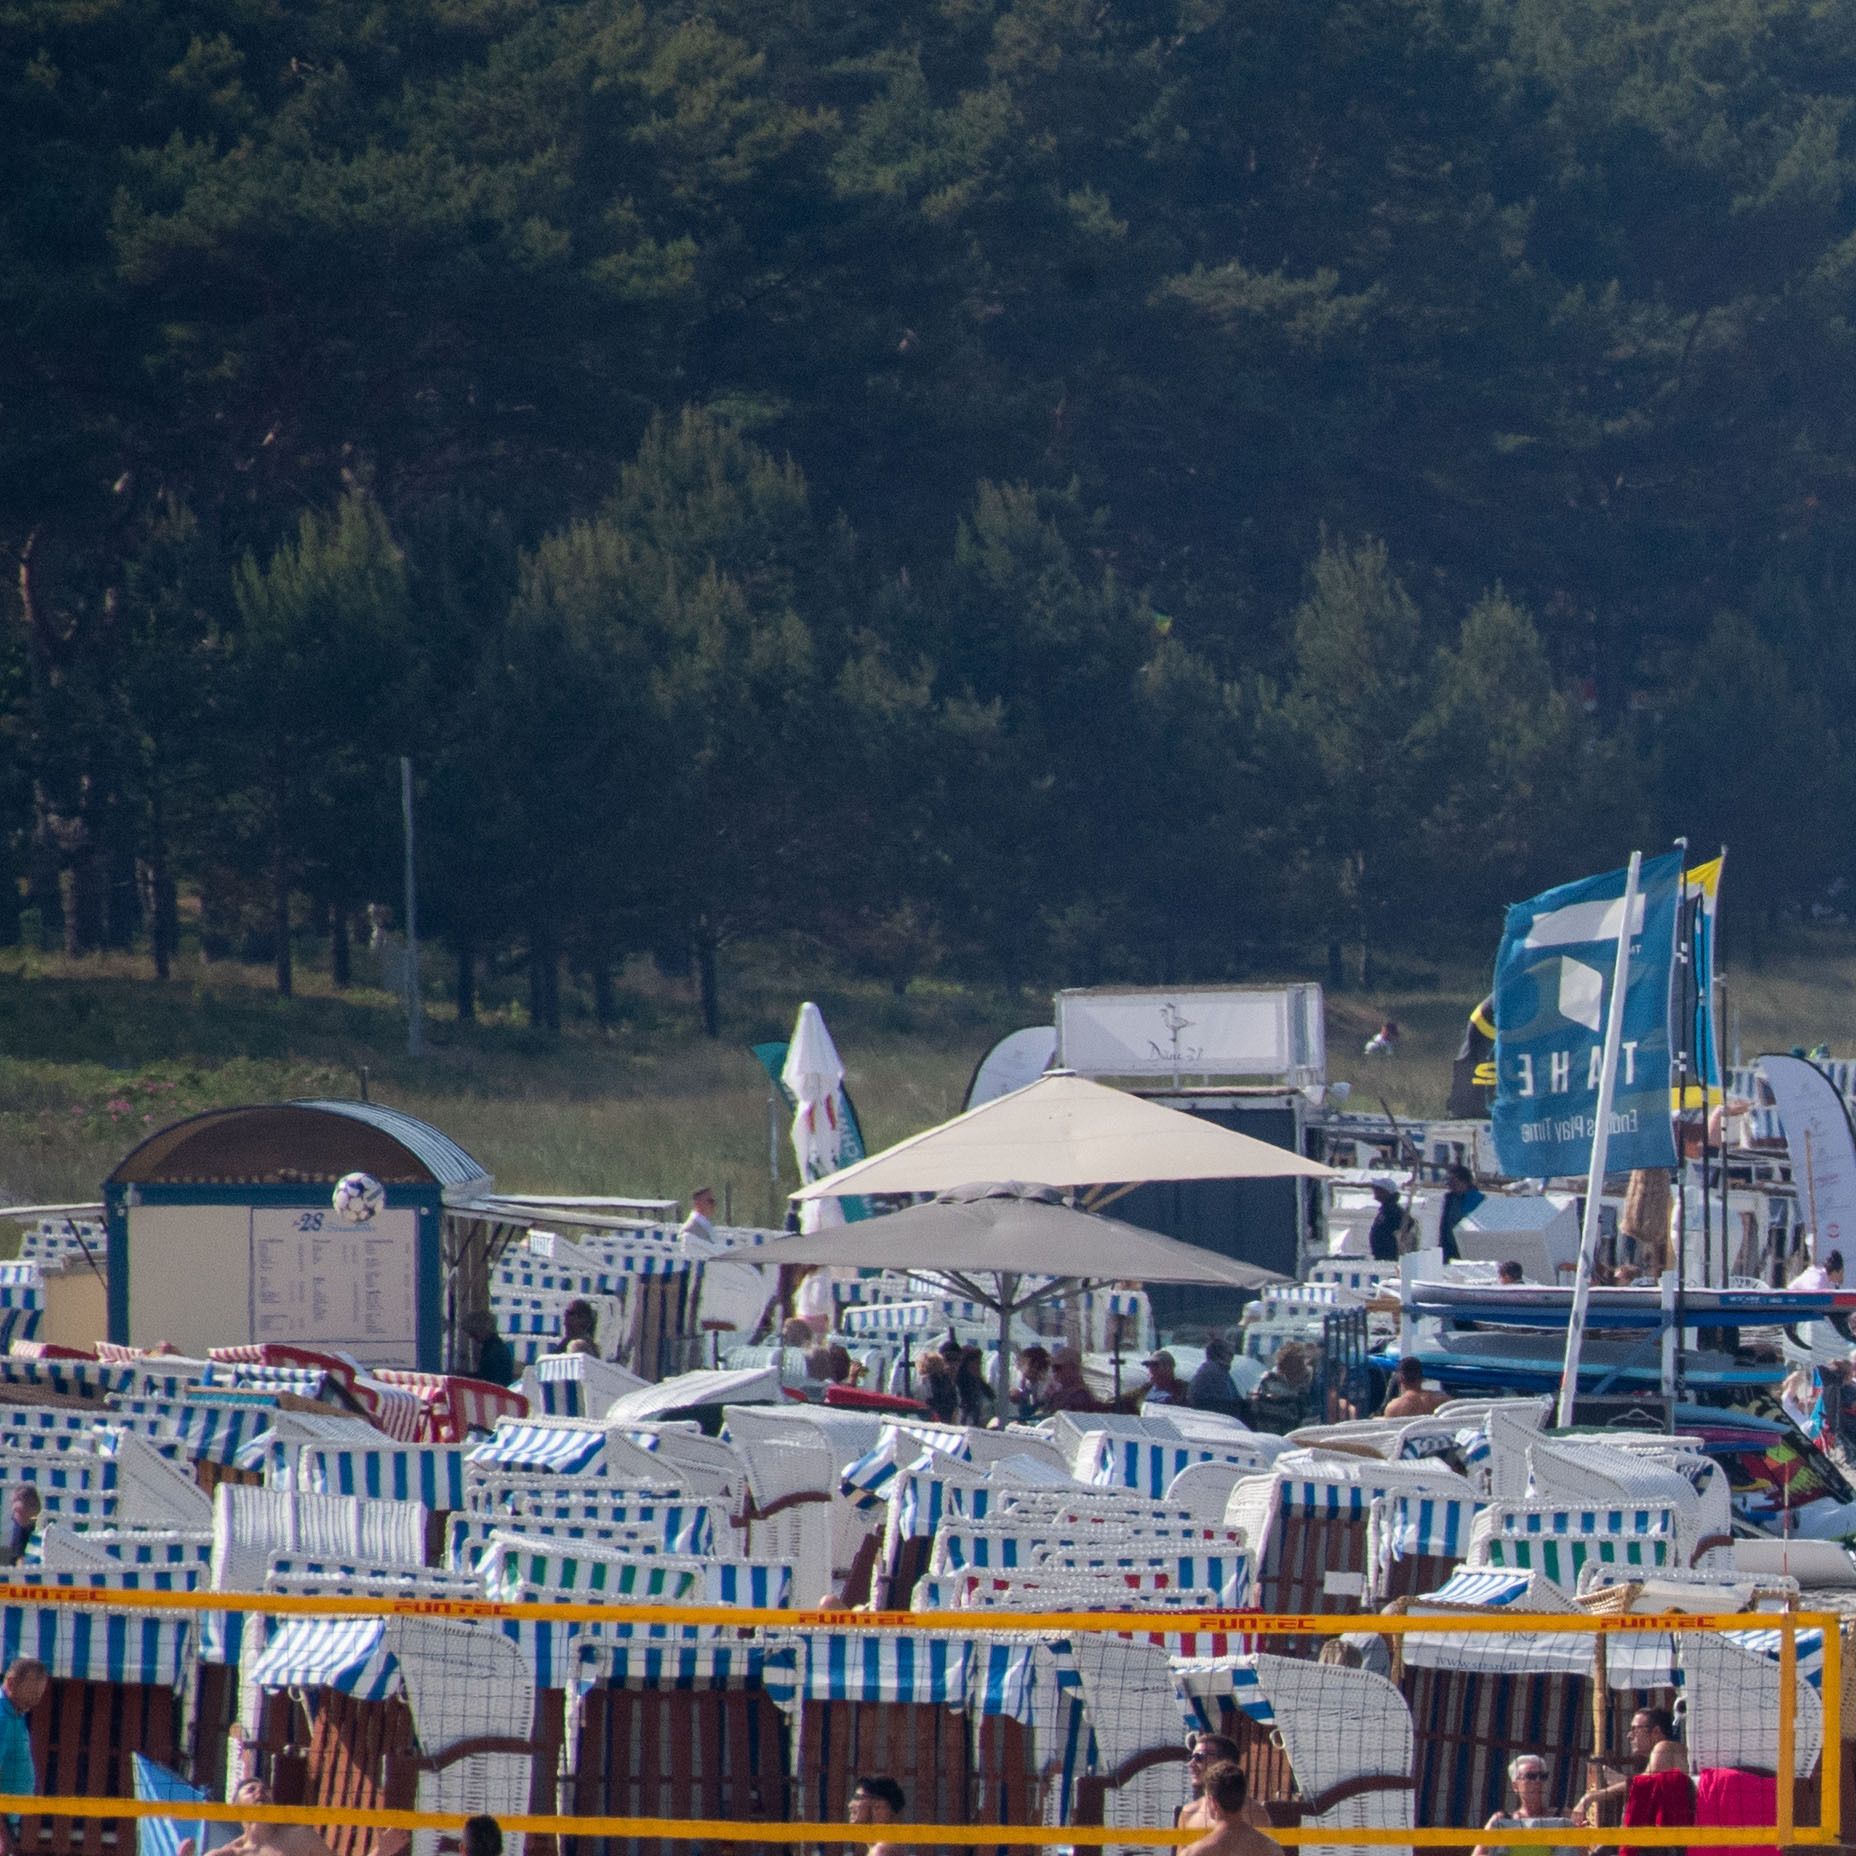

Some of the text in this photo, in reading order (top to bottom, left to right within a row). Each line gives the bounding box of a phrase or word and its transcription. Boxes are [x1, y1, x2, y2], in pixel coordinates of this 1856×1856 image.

[394, 1602, 512, 1616] FUNTEC
[799, 1611, 916, 1625] FUNTEC
[1200, 1617, 1316, 1630] FUNTEC
[1600, 1616, 1716, 1629] FUNTEC
